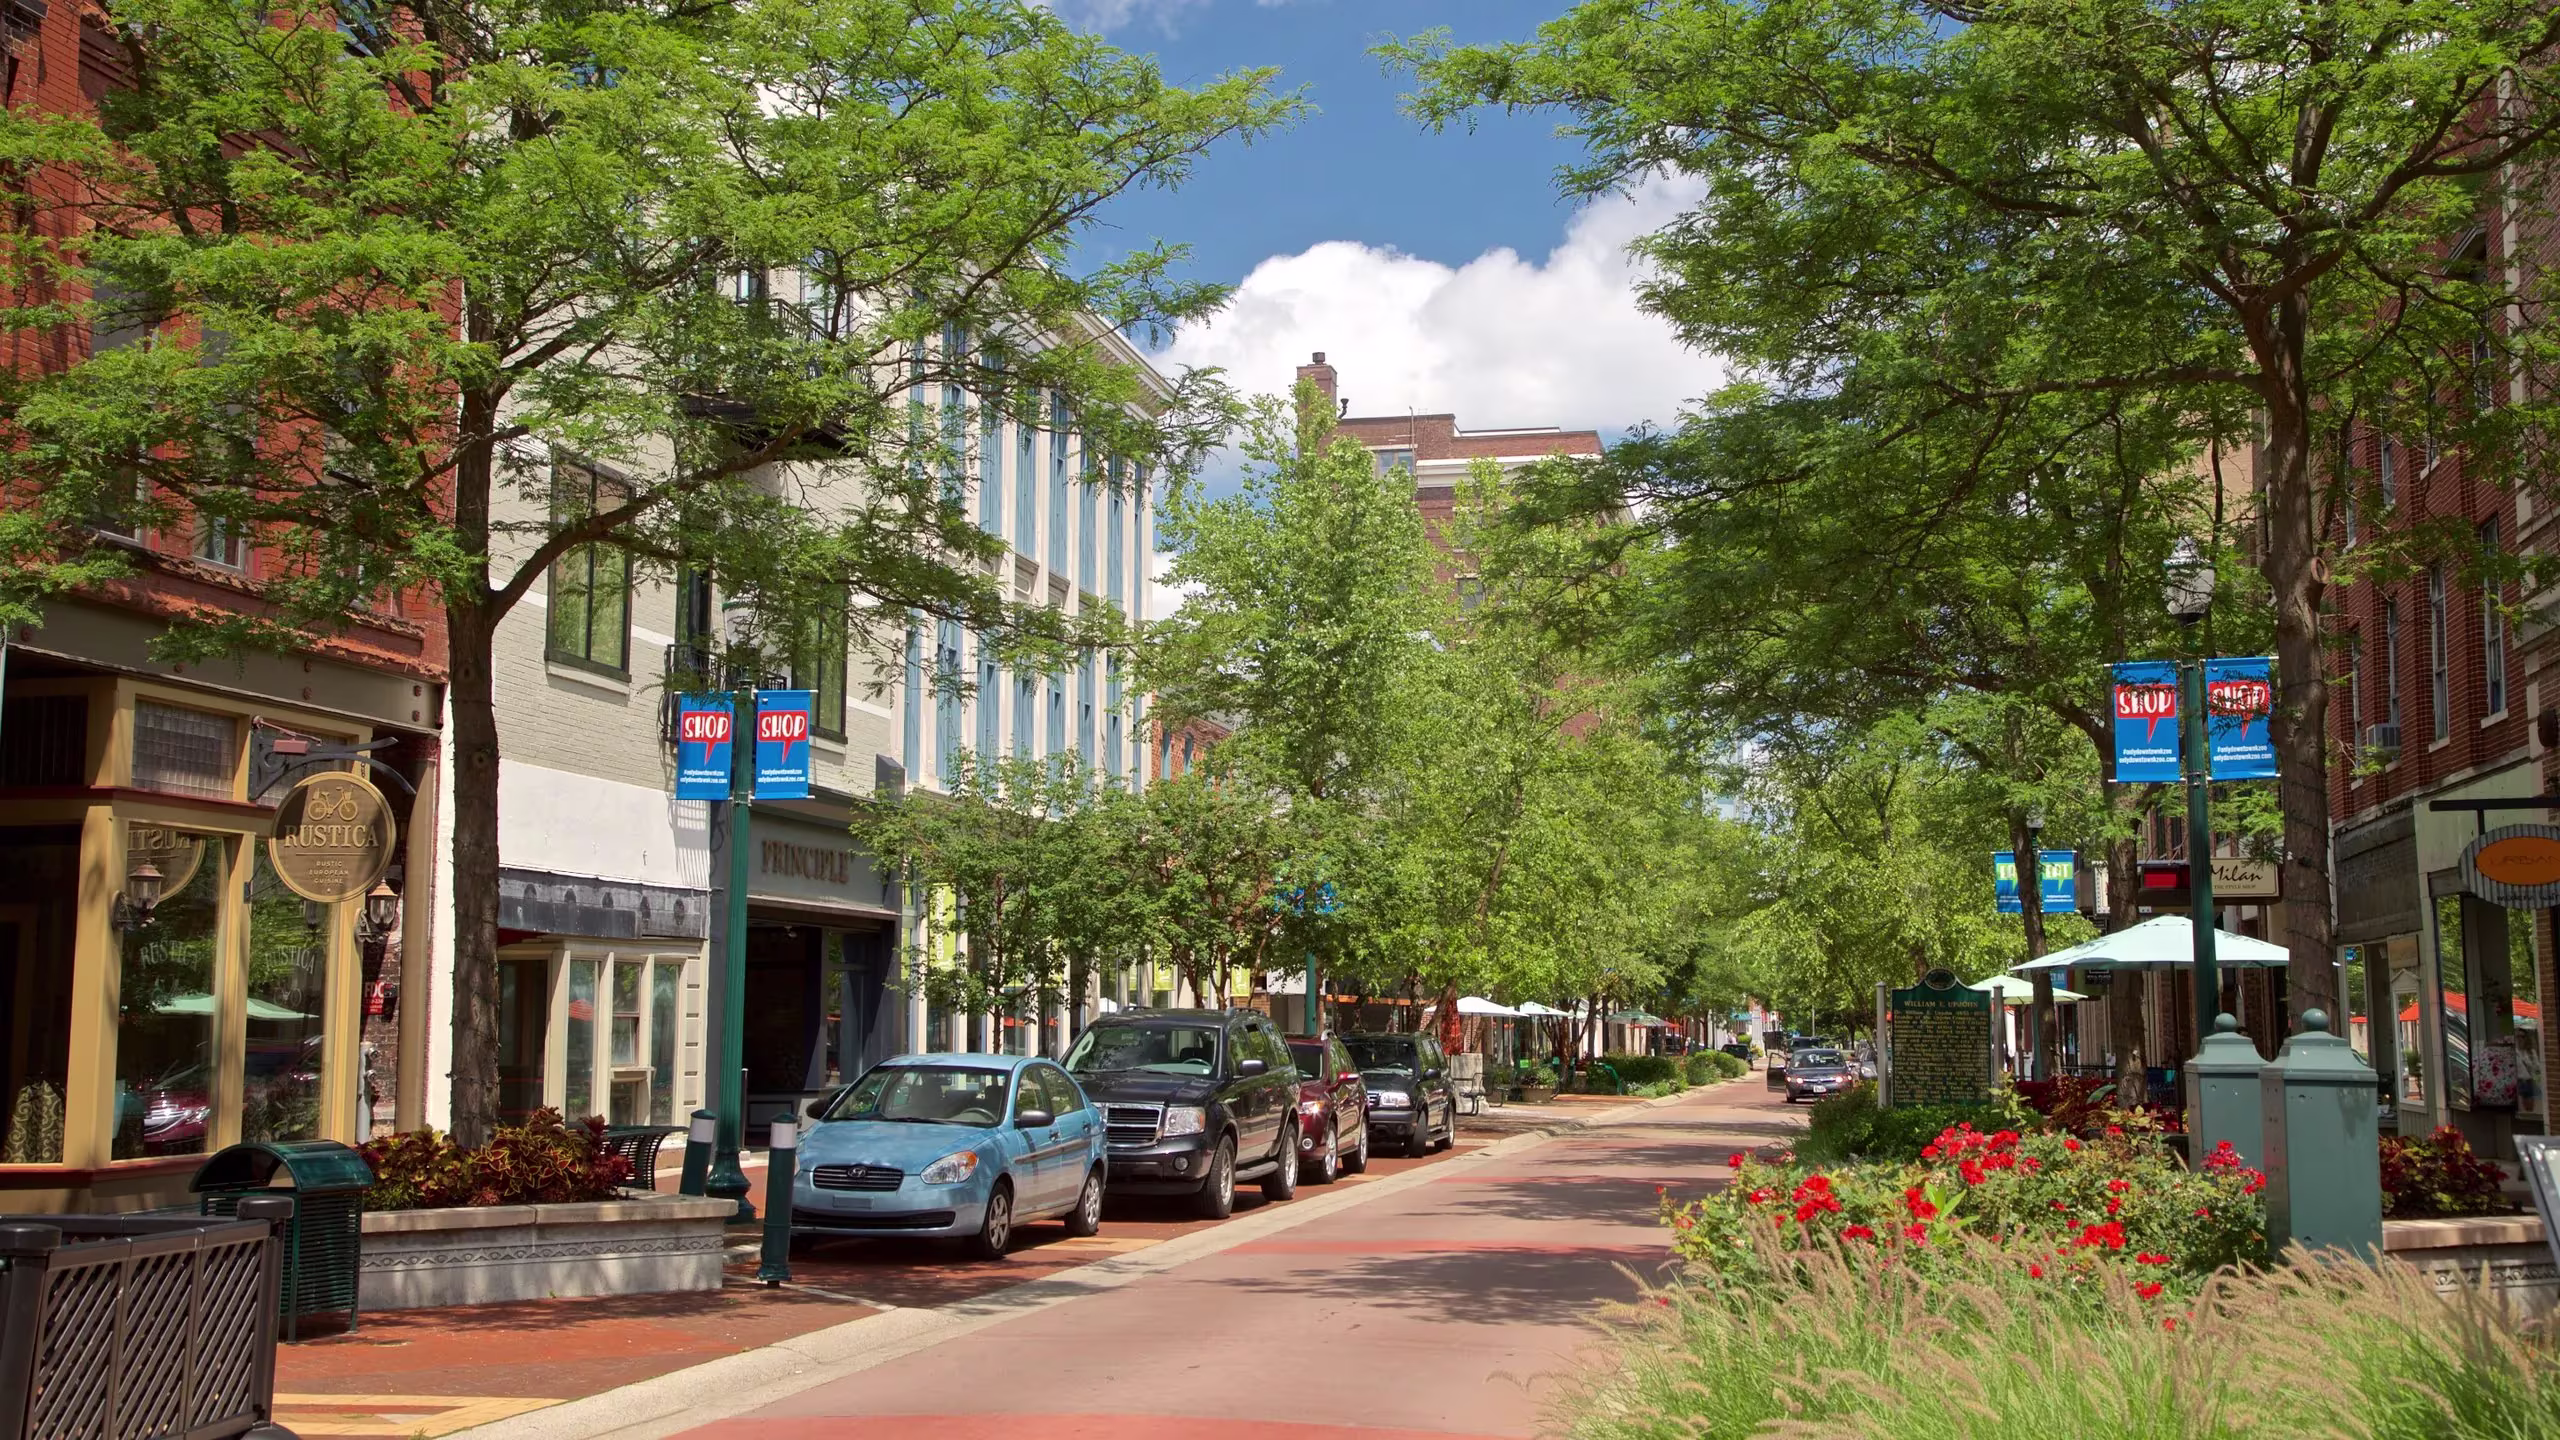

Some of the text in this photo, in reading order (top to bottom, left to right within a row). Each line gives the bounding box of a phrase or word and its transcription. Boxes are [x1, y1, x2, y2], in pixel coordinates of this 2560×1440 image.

[2119, 688, 2172, 714] SHOP
[684, 715, 729, 739] SHOP
[761, 714, 805, 738] SHOP
[283, 825, 380, 848] RUSTICA
[761, 840, 850, 885] PRINCIPLE
[2045, 863, 2069, 879] EAT
[2210, 864, 2263, 882] Milan
[140, 939, 199, 972] RUSTICA
[265, 943, 316, 975] RUSTICA
[364, 981, 385, 998] FDC
[1904, 1001, 1936, 1009] WILLIAM
[1948, 1001, 1979, 1009] UPJOHN
